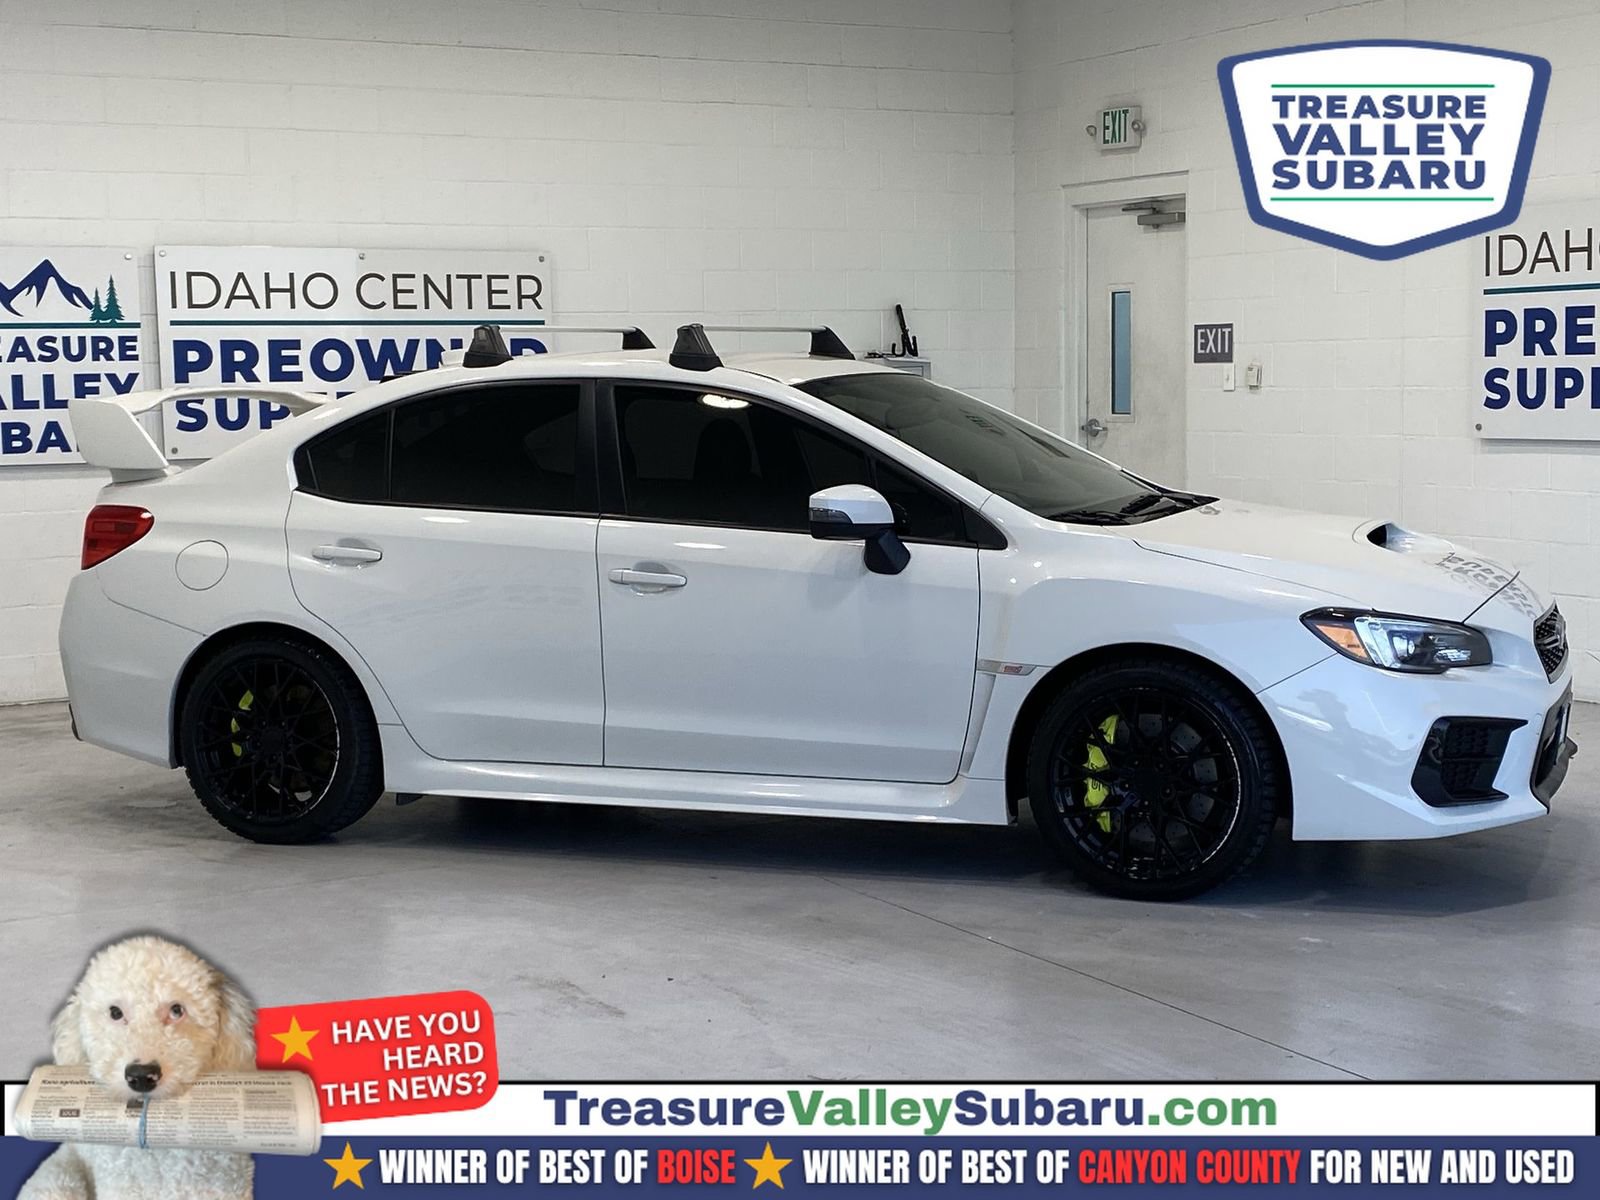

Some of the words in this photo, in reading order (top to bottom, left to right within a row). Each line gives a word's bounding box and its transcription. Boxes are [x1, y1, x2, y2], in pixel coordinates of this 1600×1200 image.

[1102, 109, 1129, 145] EXIT
[1485, 228, 1600, 277] IDAH
[169, 271, 339, 309] IDAHO
[355, 272, 543, 309] CENTER
[0, 335, 139, 363] ASURE
[1197, 328, 1231, 353] EXIT
[172, 337, 549, 384] PREOWN
[0, 421, 80, 454] BA
